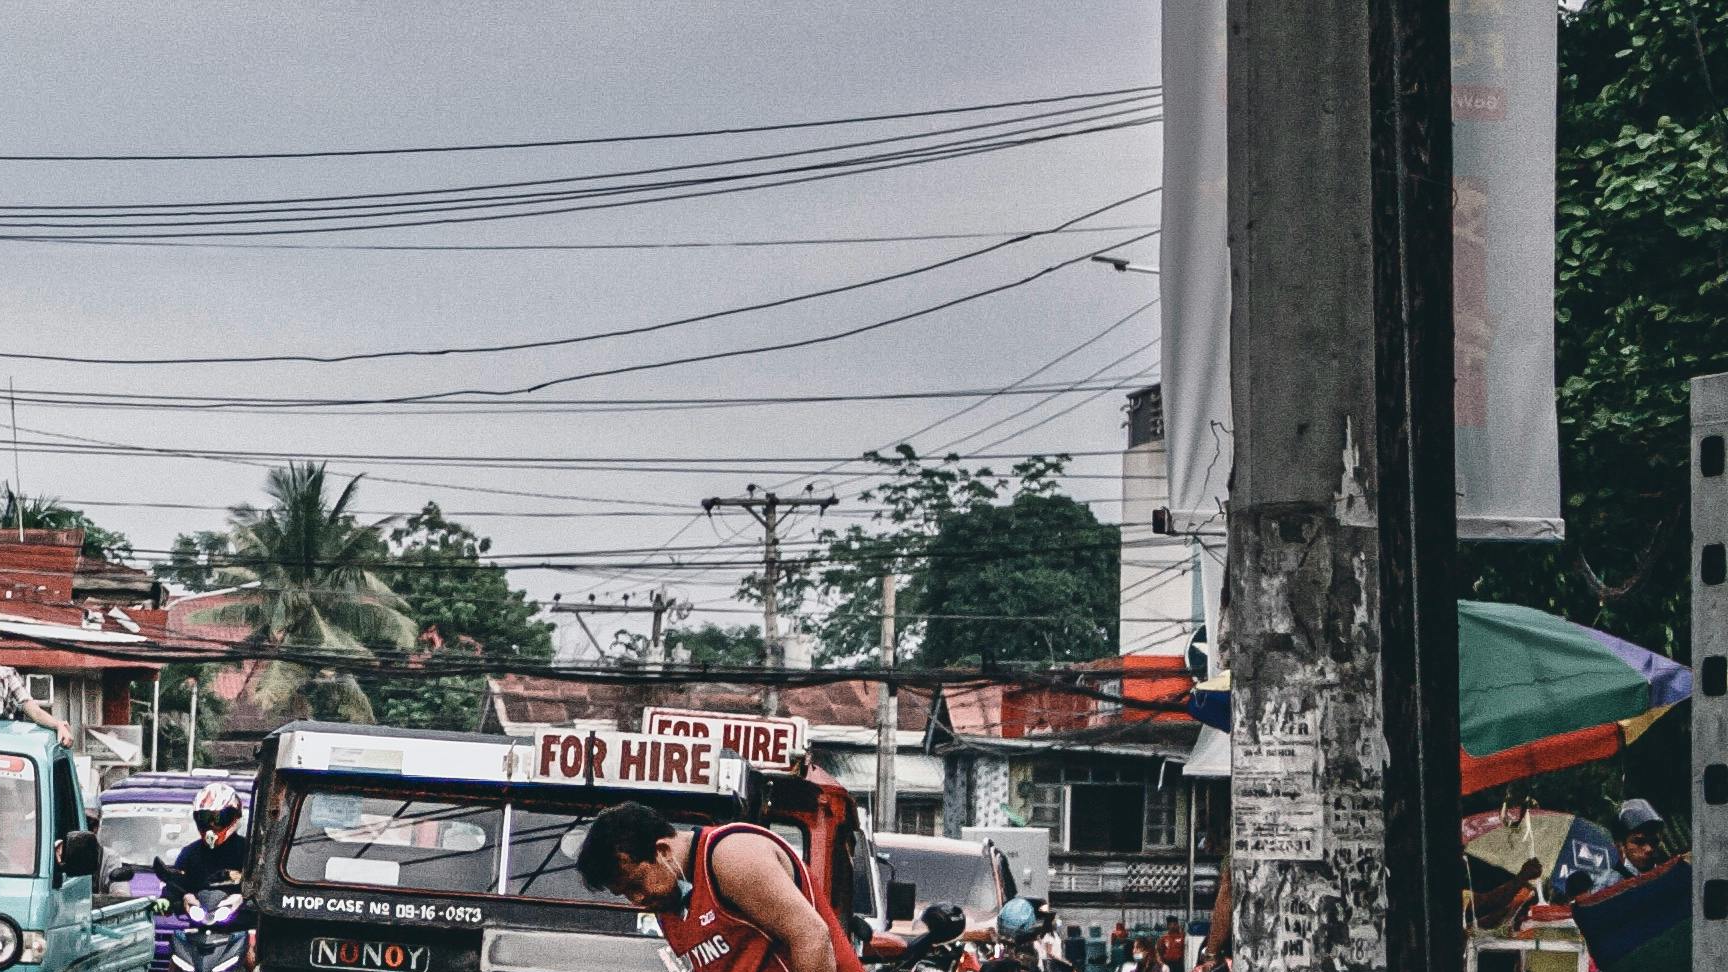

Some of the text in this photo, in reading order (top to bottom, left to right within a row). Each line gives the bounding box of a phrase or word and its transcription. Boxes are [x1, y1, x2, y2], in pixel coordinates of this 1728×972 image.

[539, 734, 712, 785] FOR HIRE
[722, 724, 790, 763] HIRE
[282, 895, 324, 910] MTOP
[326, 899, 365, 914] CASE
